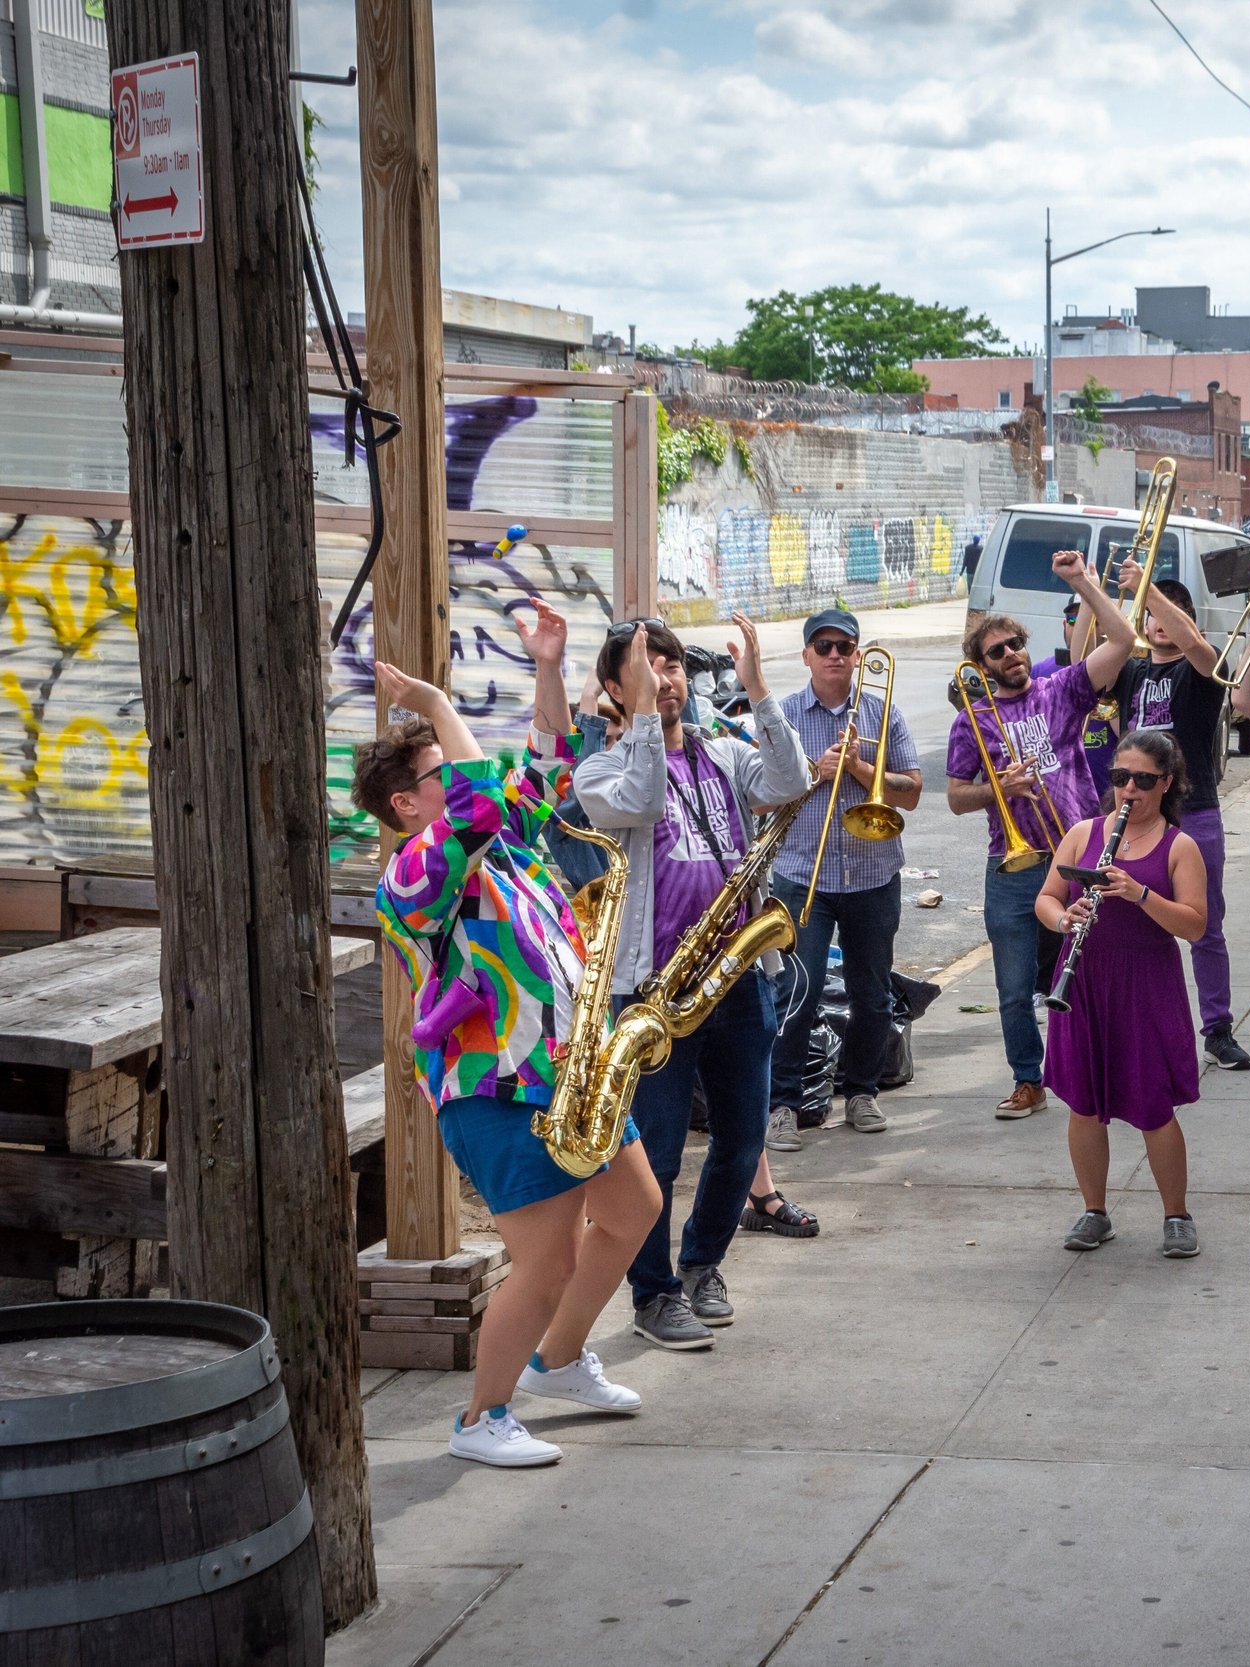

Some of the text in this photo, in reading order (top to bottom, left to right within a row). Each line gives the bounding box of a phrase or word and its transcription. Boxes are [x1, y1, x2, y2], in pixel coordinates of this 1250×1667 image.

[140, 89, 166, 113] Monday
[142, 116, 171, 137] Thursday
[143, 154, 168, 175] 9:30am
[173, 151, 190, 171] 11am
[1013, 713, 1050, 748] TRAIN
